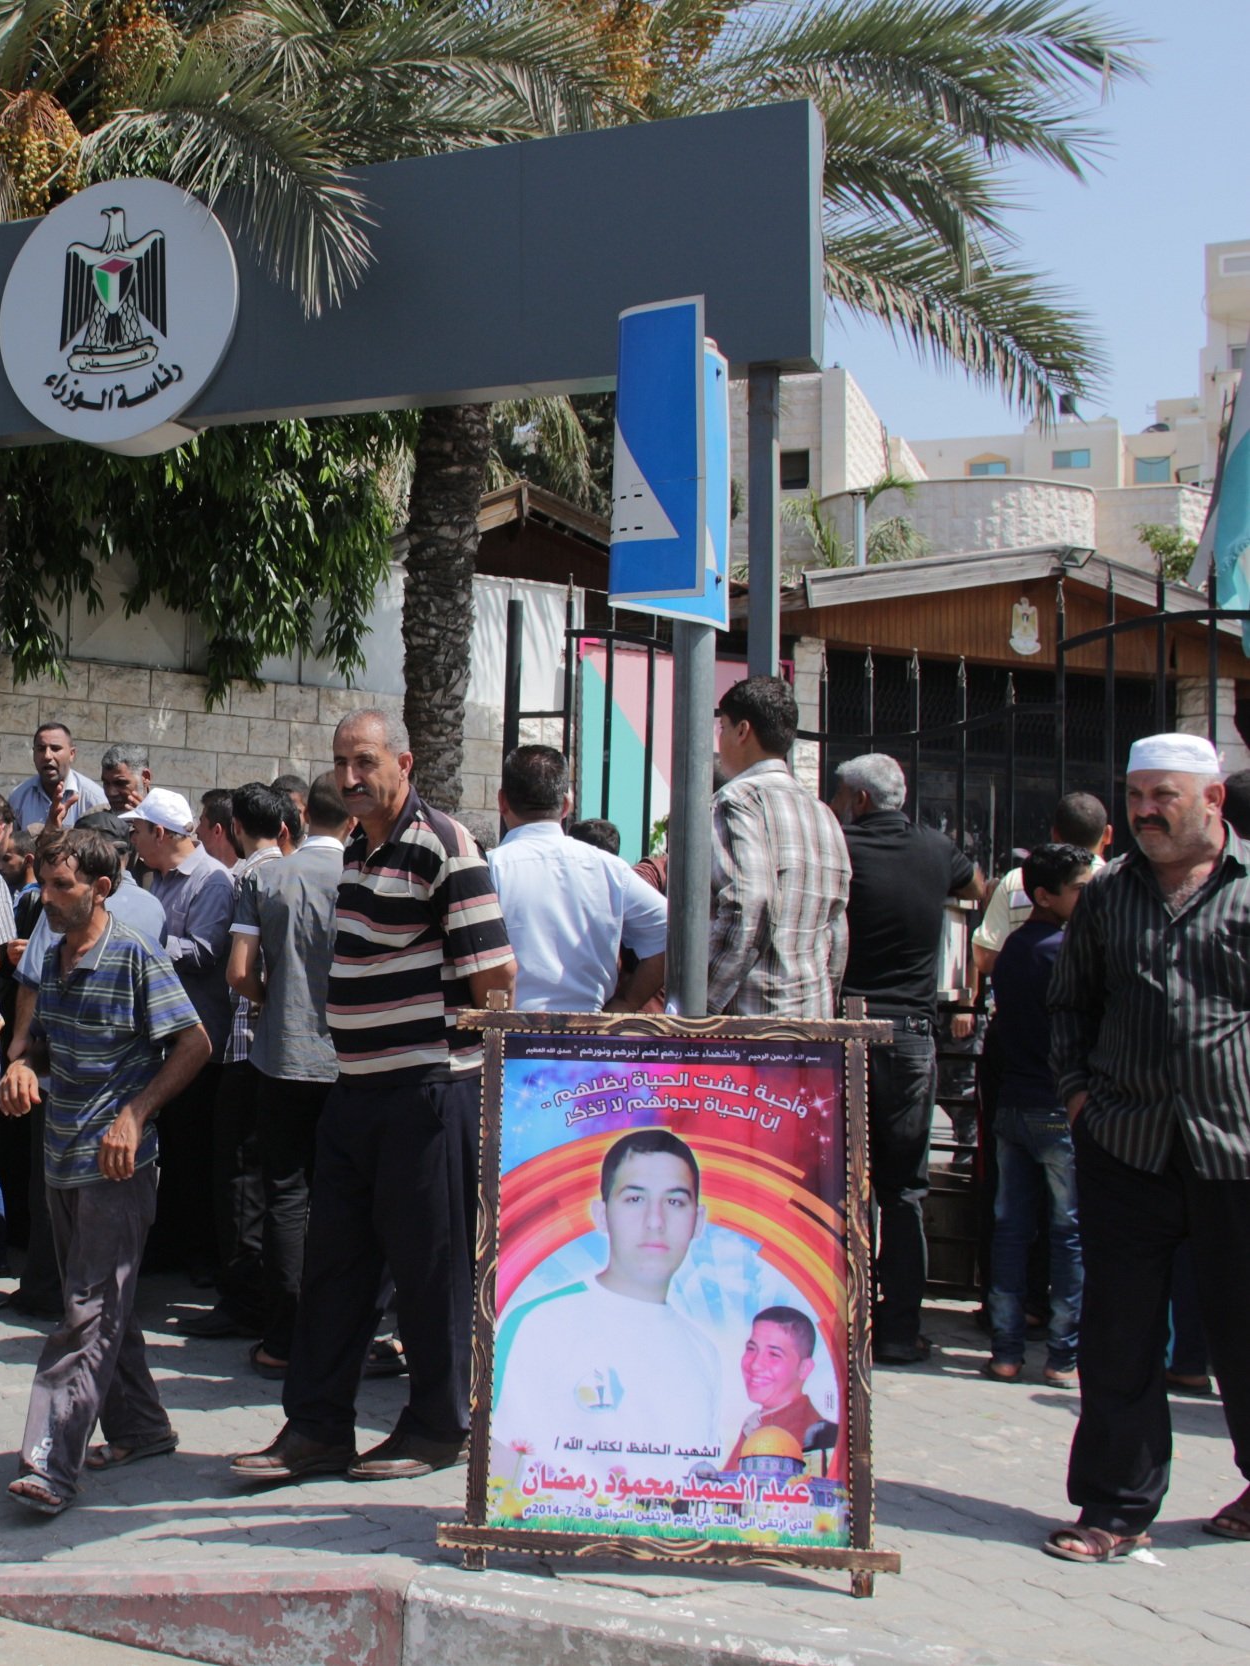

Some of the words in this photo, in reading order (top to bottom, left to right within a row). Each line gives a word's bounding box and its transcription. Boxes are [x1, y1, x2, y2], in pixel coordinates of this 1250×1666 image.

[79, 350, 149, 371] فلسطين
[44, 372, 114, 411] الوزراء
[115, 363, 183, 408] رئاسة
[579, 1047, 611, 1057] ونورهم
[641, 1048, 658, 1059] لهم
[661, 1049, 682, 1060] ربهم
[684, 1048, 699, 1057] عند
[748, 1053, 768, 1061] الرحيم
[770, 1053, 792, 1061] الرحمن
[631, 1071, 689, 1090] الحياة
[693, 1075, 749, 1096] عشت
[554, 1075, 628, 1107] بظلهم
[611, 1097, 623, 1112] لا
[627, 1094, 700, 1113] بدونهم
[703, 1096, 758, 1121] الحياة
[565, 1100, 607, 1127] تذكر
[759, 1112, 781, 1132] إن
[563, 1436, 583, 1450] الله
[586, 1440, 622, 1455] لكتاب
[626, 1441, 671, 1455] الحافظ
[674, 1446, 720, 1460] الشهيد
[522, 1464, 598, 1499] رمضان
[605, 1473, 674, 1501] محمود
[682, 1474, 756, 1501] الصمد
[762, 1477, 810, 1512] عبد
[594, 1509, 633, 1520] الموافق
[674, 1515, 693, 1526] يوم
[696, 1516, 710, 1527] في
[789, 1519, 812, 1531] الذي
